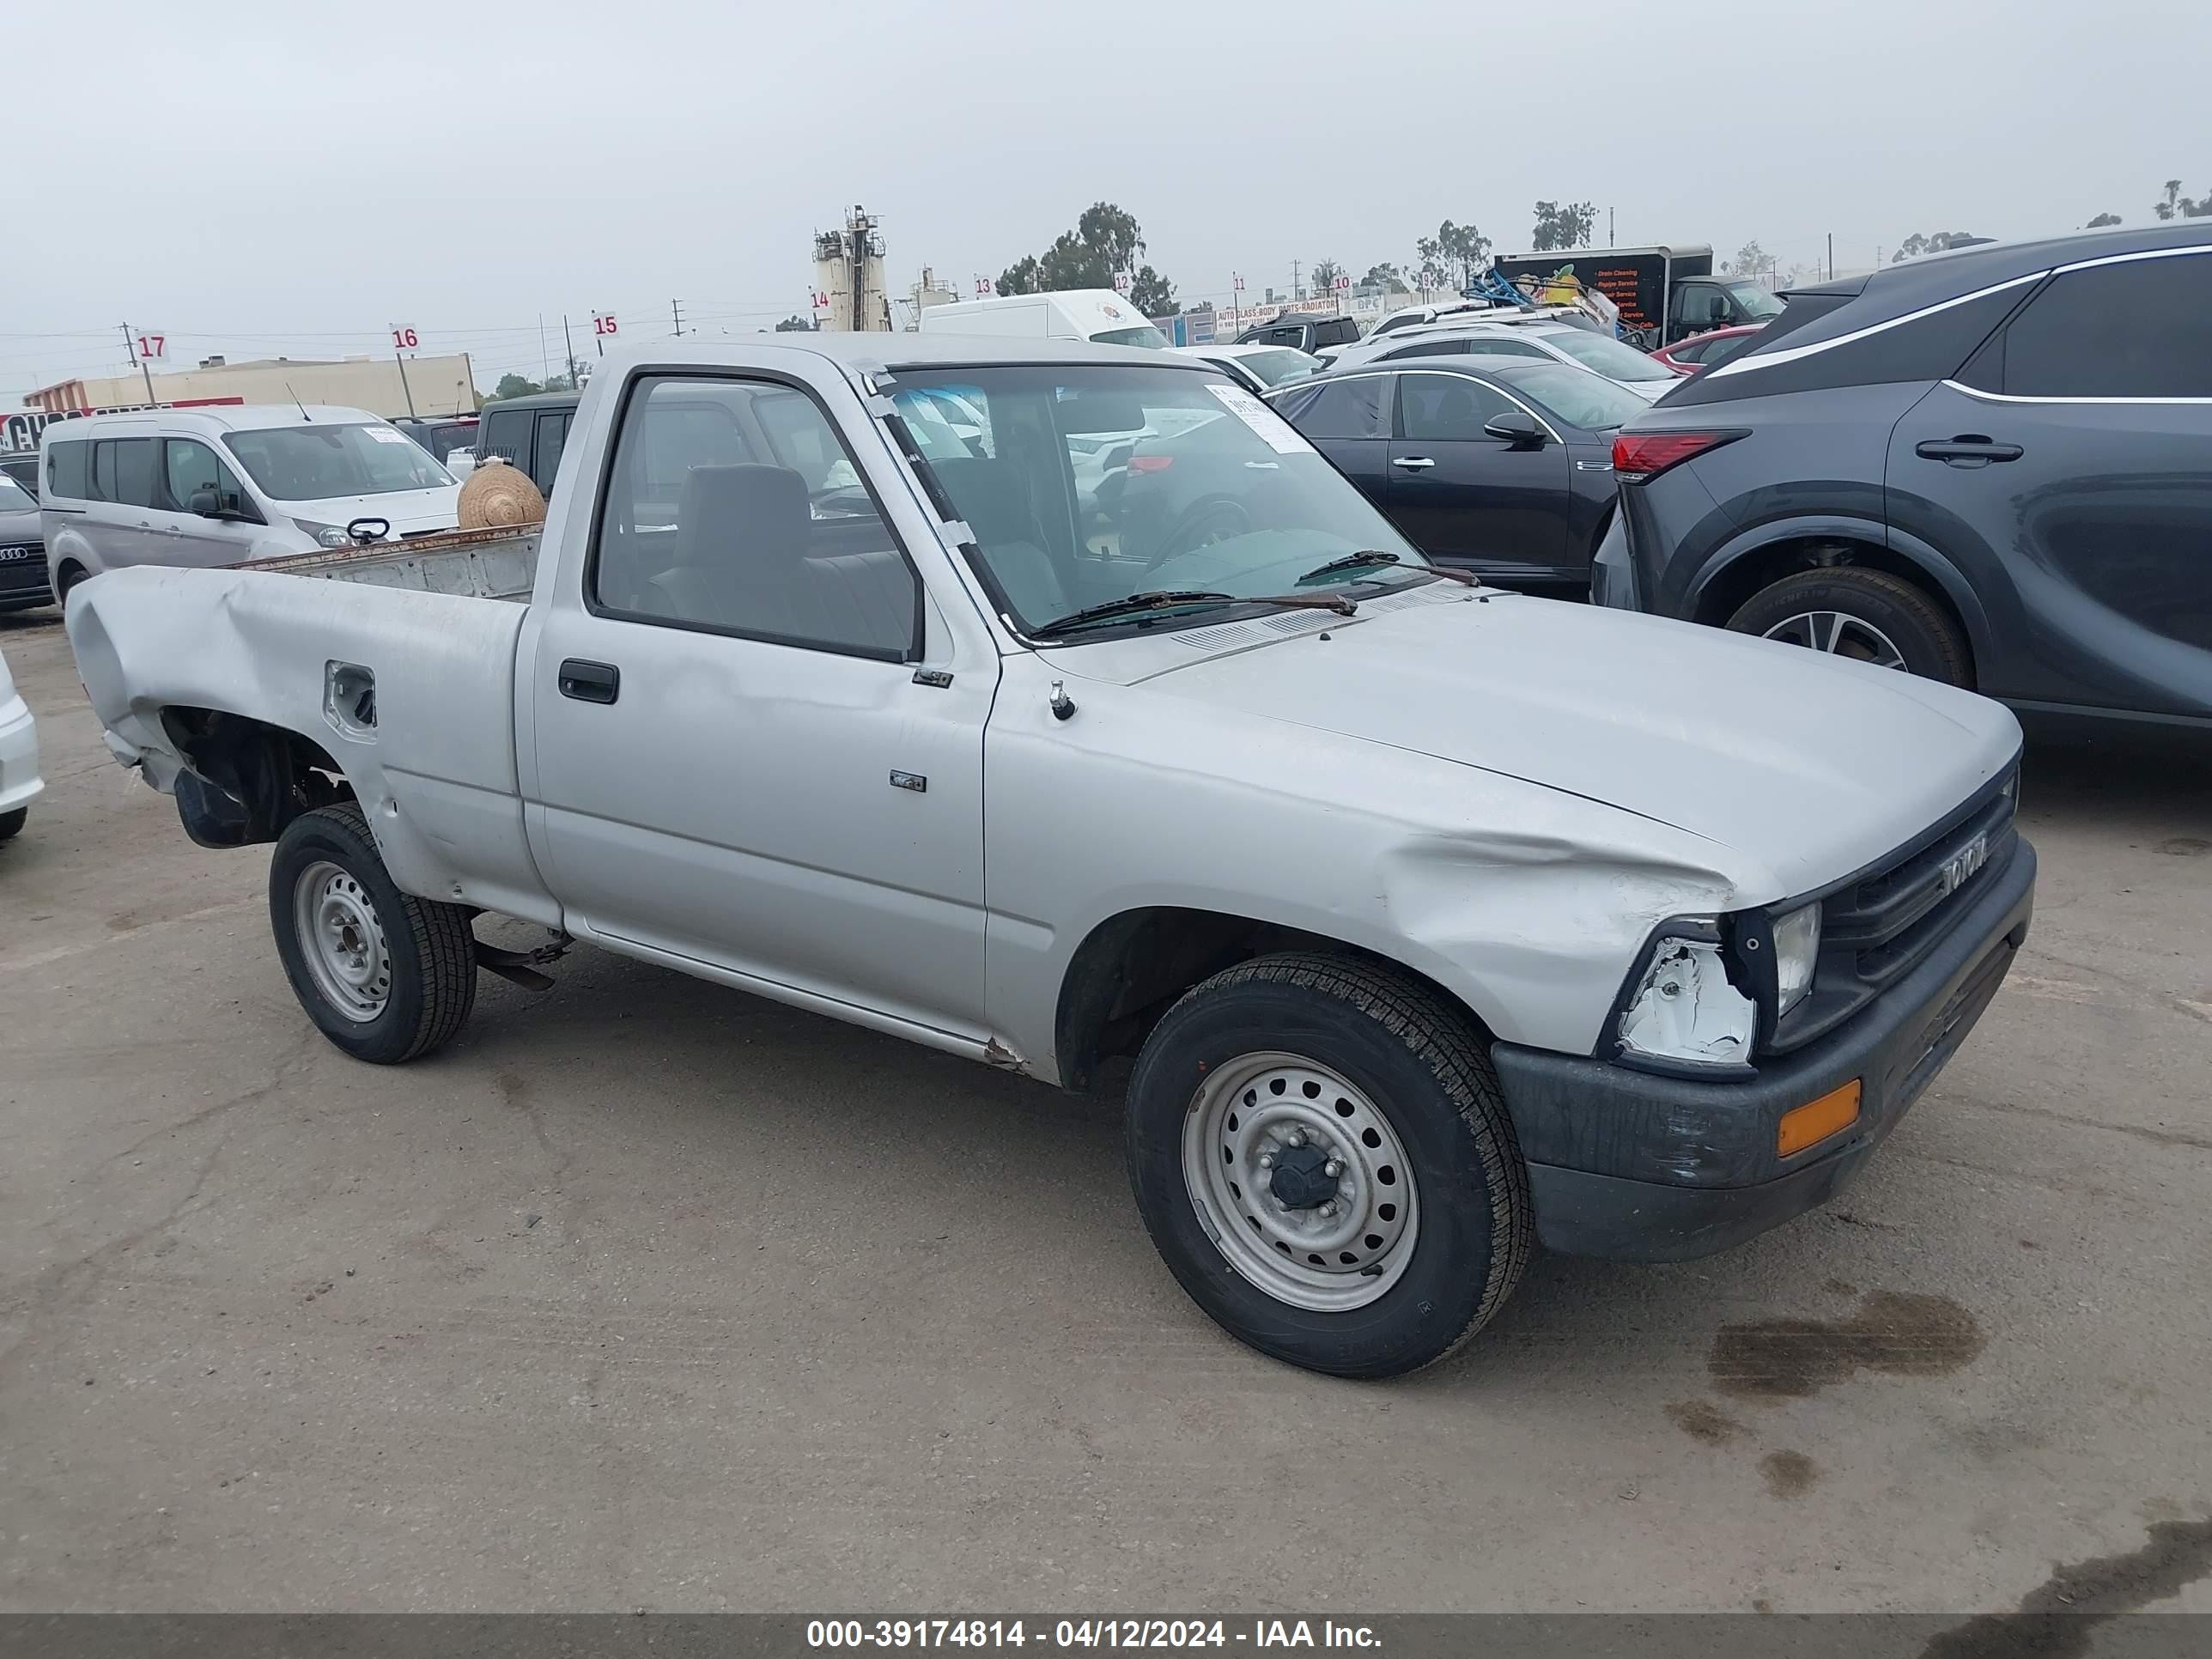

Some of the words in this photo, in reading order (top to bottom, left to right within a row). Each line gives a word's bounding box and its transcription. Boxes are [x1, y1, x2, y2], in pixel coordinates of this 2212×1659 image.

[975, 279, 991, 294] 13
[1115, 275, 1128, 289] 12
[1235, 278, 1245, 290] 11
[1335, 276, 1350, 289] 10
[1424, 274, 1430, 287] 9
[811, 293, 829, 308] 14
[1218, 310, 1235, 321] AUTO
[593, 316, 617, 335] 15
[392, 329, 418, 348] 16
[138, 337, 165, 357] 17
[1943, 836, 1987, 895] TOYOTA
